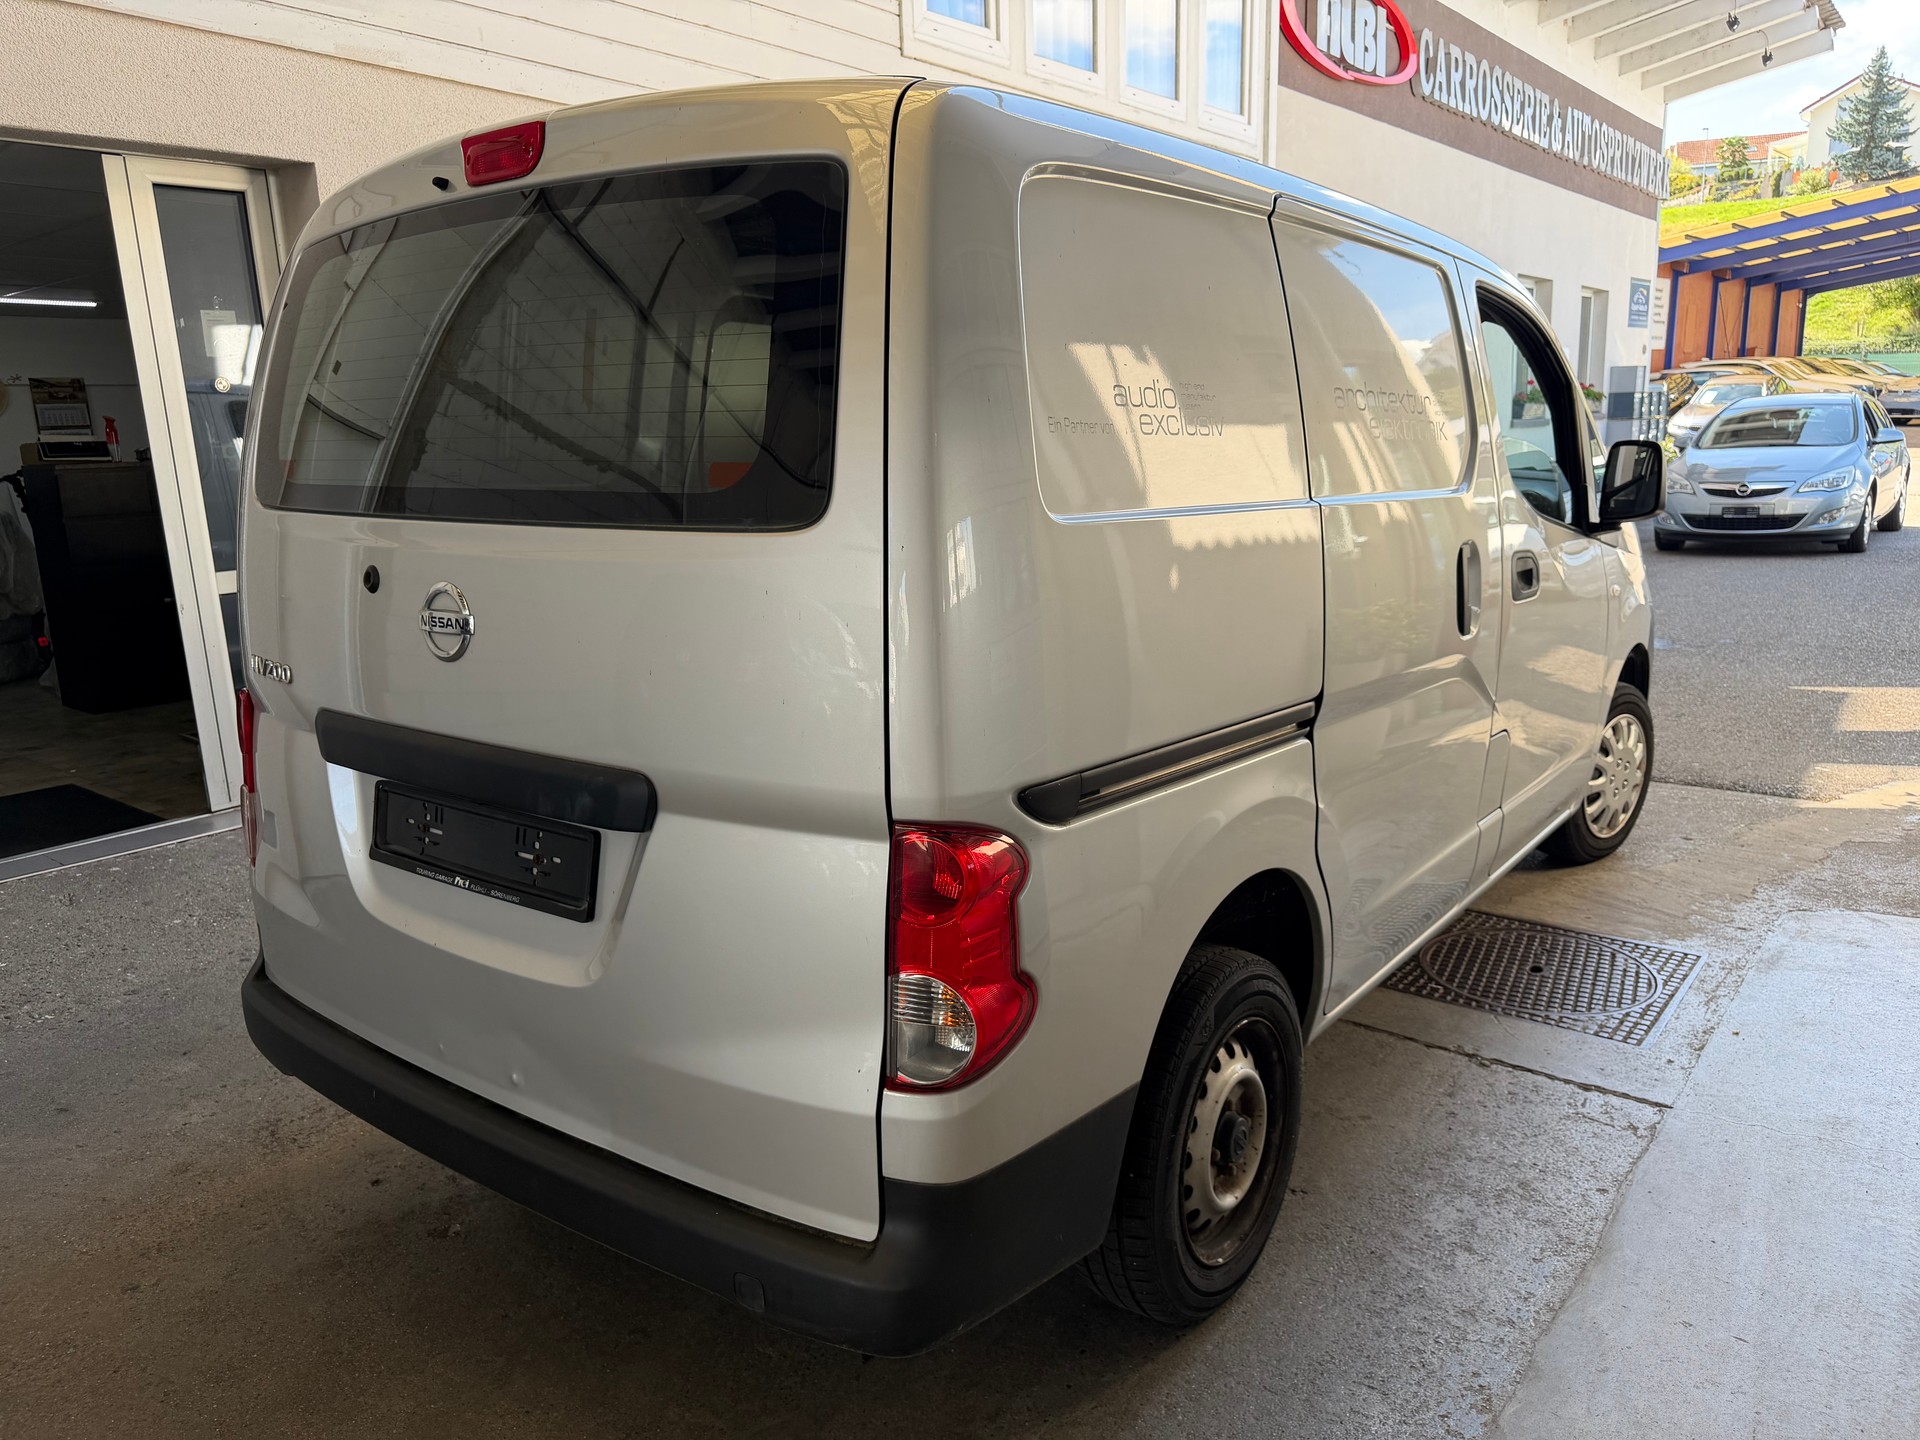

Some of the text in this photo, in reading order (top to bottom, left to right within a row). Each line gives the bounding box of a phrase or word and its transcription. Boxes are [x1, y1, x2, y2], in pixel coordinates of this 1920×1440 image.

[1418, 27, 1671, 199] CARROSSERIE & AUTOSPRITZWERK
[1112, 379, 1177, 410] audio
[1333, 381, 1432, 415] architektur
[1047, 416, 1061, 434] Ein
[1063, 416, 1097, 435] Partner
[1139, 407, 1225, 437] exclusiv
[420, 615, 465, 631] NISSAN
[415, 867, 435, 878] TOURING
[435, 873, 454, 884] GARAGE
